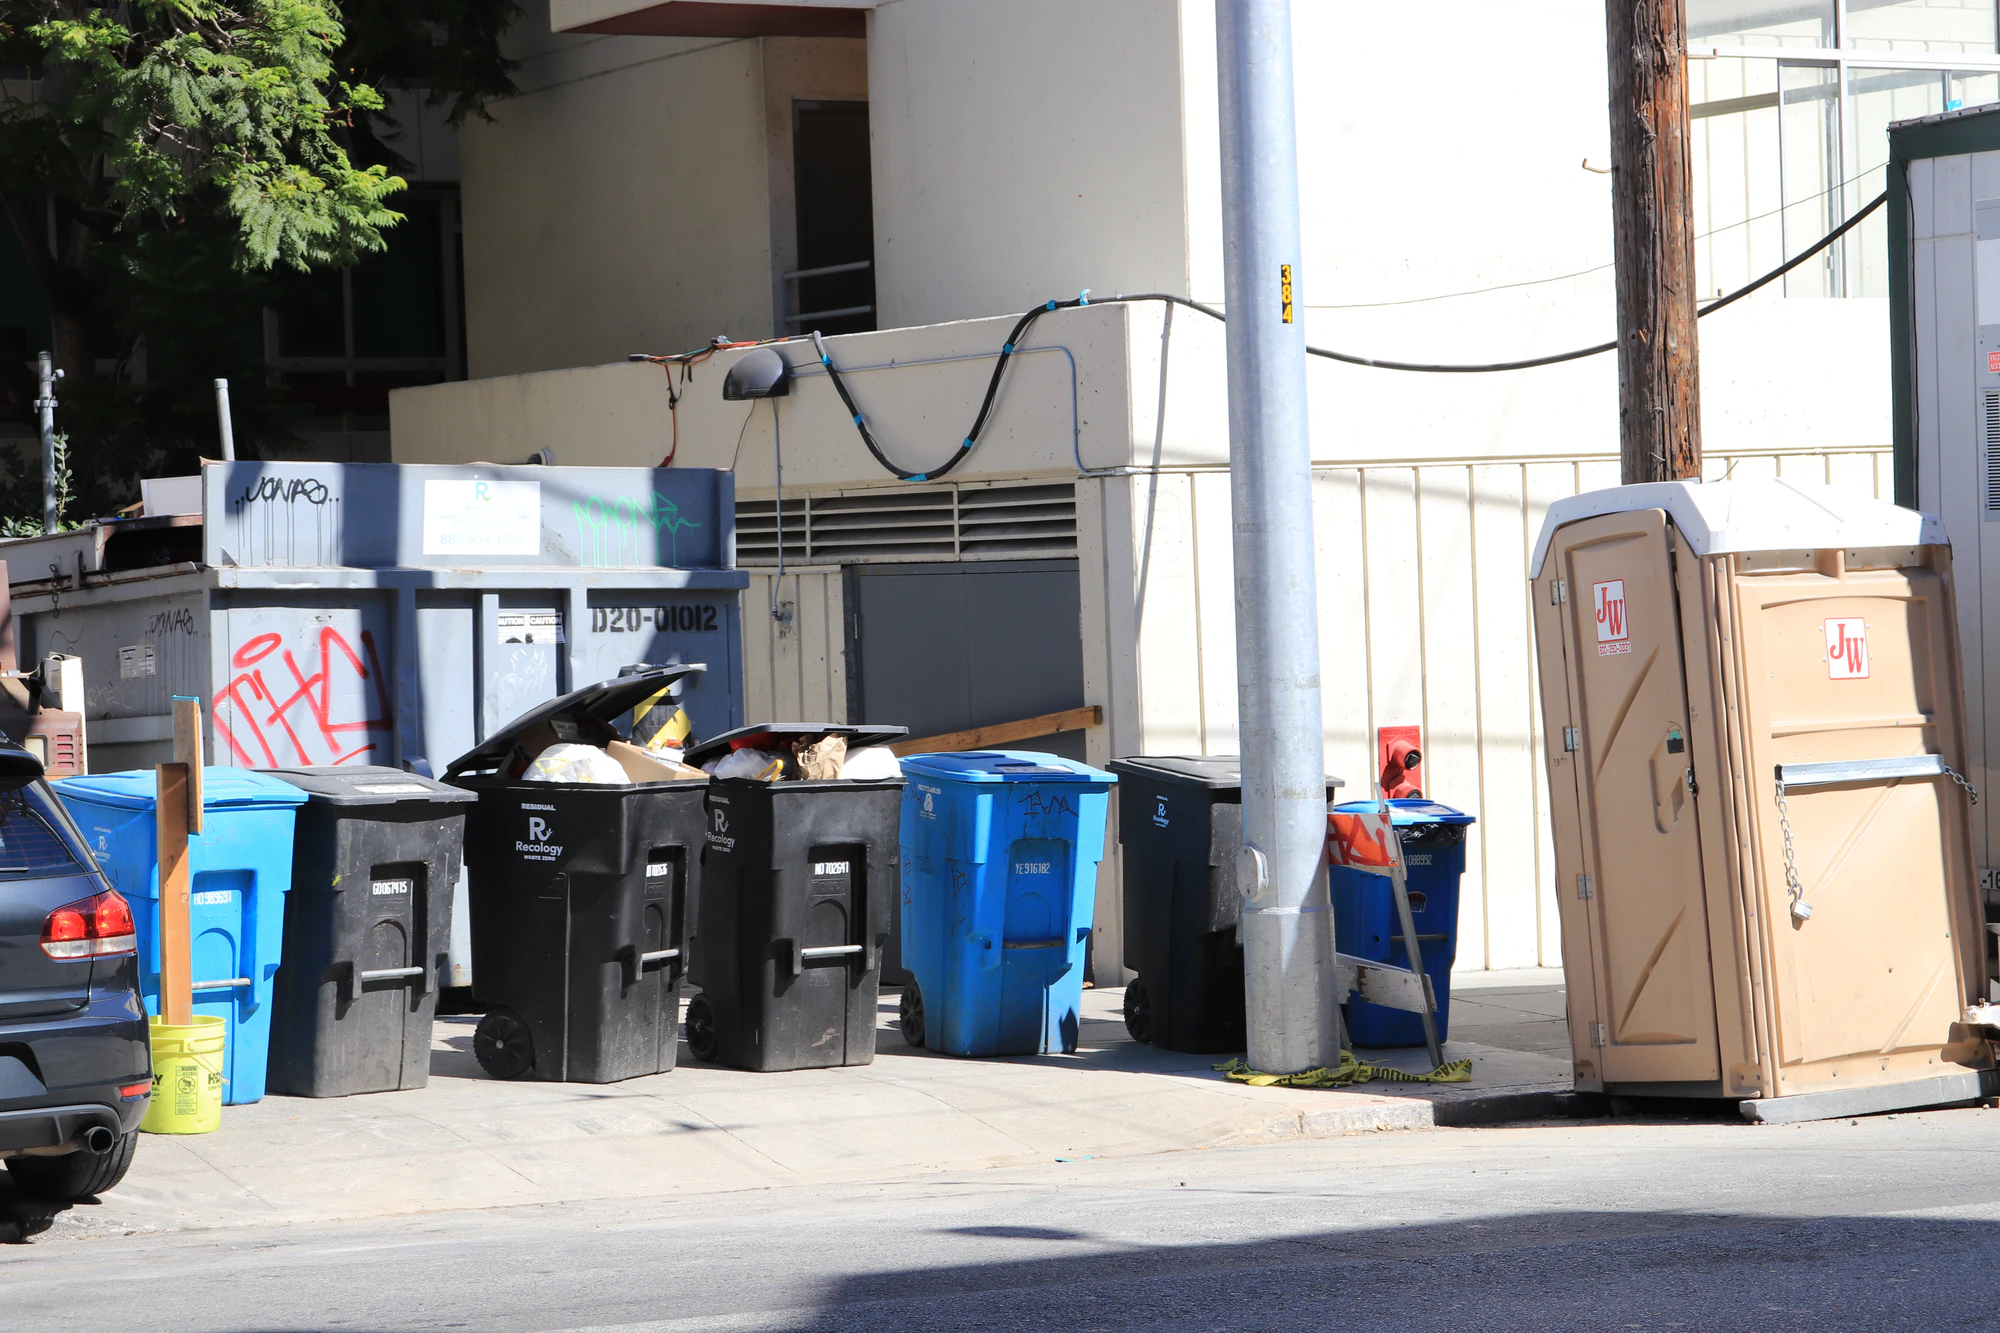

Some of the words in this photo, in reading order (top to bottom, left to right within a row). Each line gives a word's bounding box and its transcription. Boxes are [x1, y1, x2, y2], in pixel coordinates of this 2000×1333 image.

[1281, 264, 1293, 324] 384
[592, 605, 718, 632] D20-01012
[1597, 586, 1624, 635] JW
[499, 616, 524, 625] AUTION
[529, 616, 562, 625] CAUTION
[1829, 623, 1865, 673] JW
[521, 803, 556, 811] RESIDUAL
[707, 831, 735, 848] Recology
[515, 841, 563, 857] Recology
